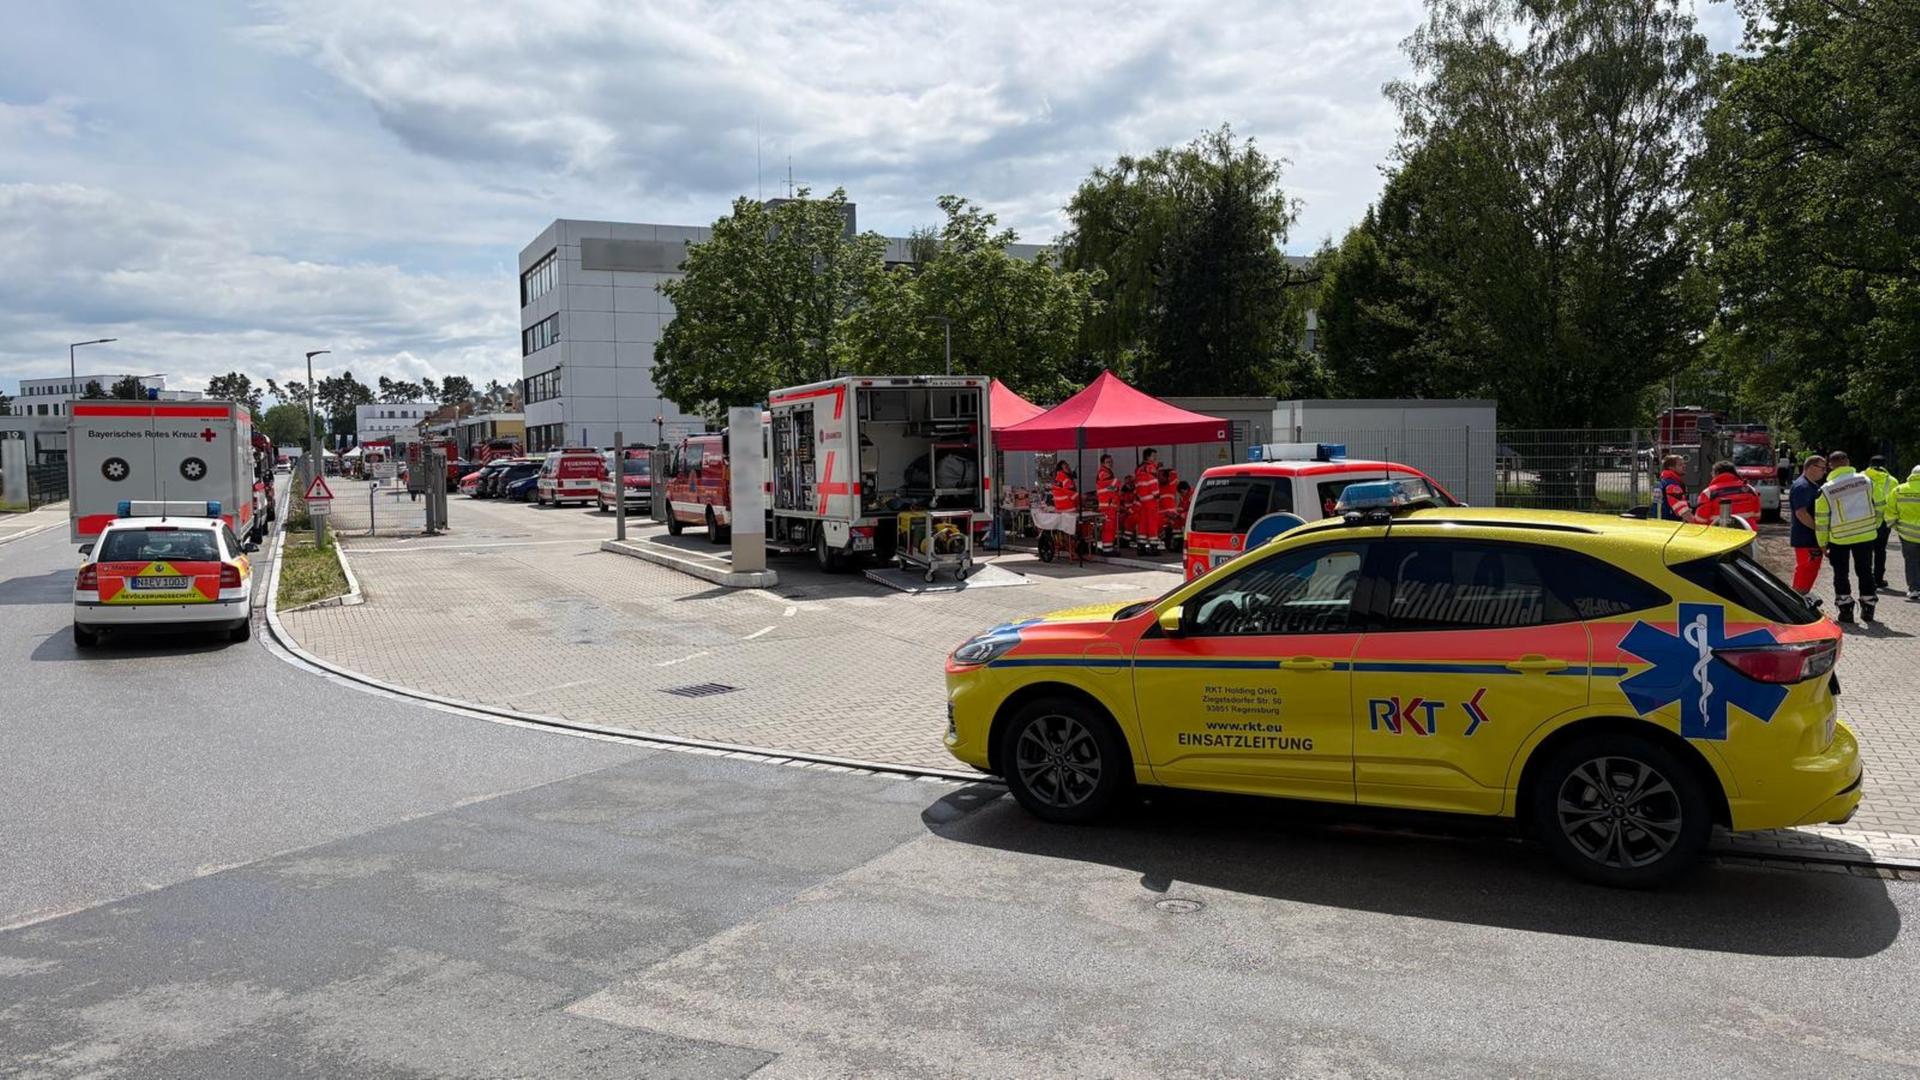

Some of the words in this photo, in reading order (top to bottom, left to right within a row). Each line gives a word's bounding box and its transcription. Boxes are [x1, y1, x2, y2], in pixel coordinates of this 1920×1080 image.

[87, 429, 143, 440] Bayerisches
[144, 429, 170, 439] Rotes
[172, 429, 198, 439] Kreuz
[163, 577, 187, 587] 1003
[1205, 686, 1223, 694] RKT
[1224, 687, 1256, 696] Holding
[1257, 687, 1278, 696] OHG
[1231, 705, 1281, 716] Regensburg
[1368, 697, 1446, 736] RKT
[1206, 720, 1283, 733] www.rkt.eu
[1178, 732, 1314, 751] EINSATZLEITUNG
